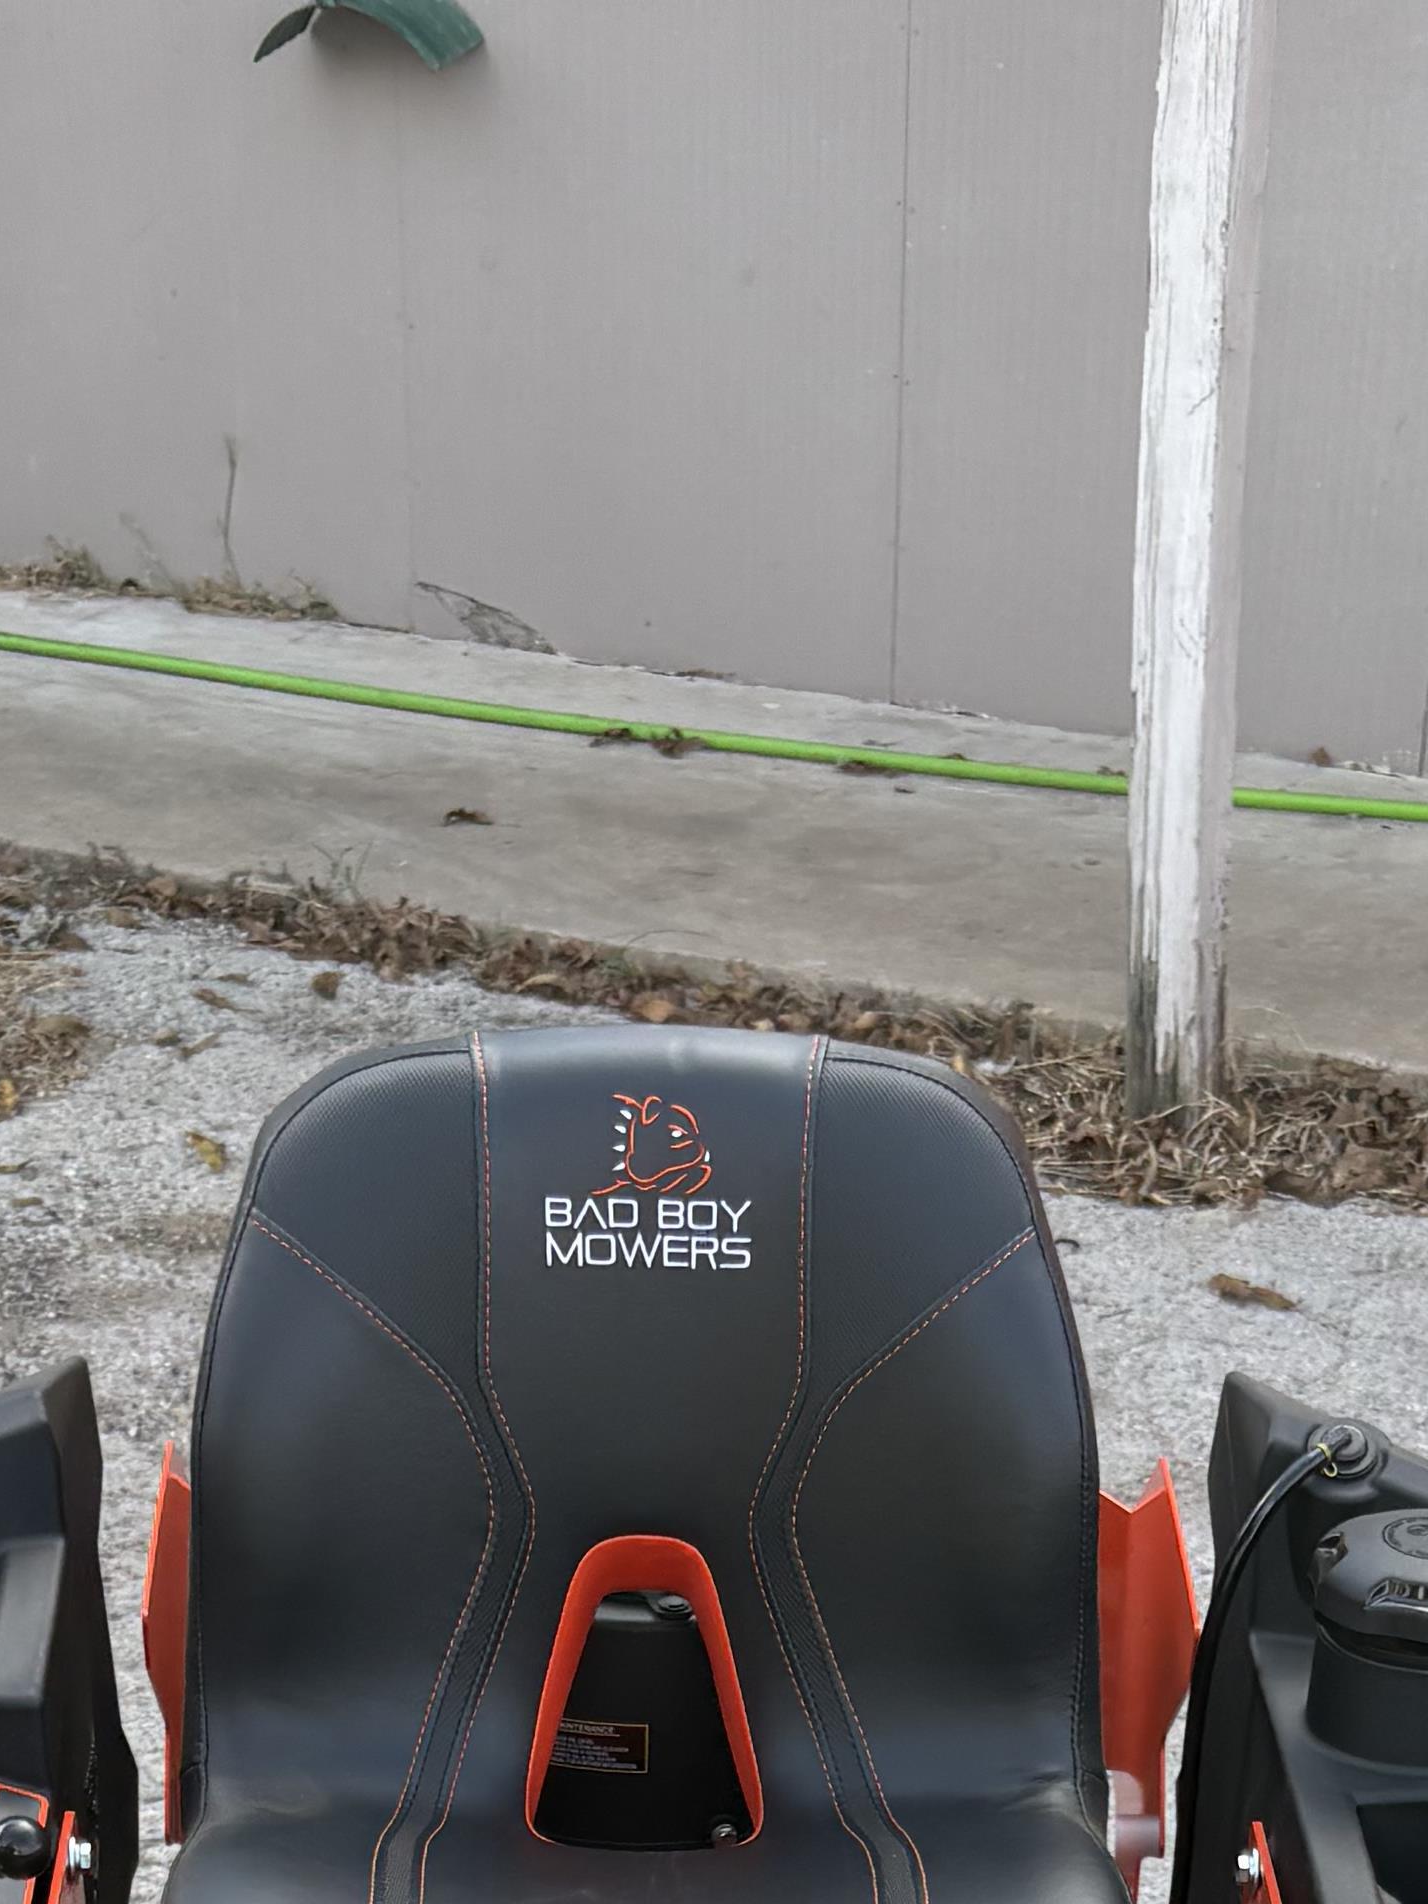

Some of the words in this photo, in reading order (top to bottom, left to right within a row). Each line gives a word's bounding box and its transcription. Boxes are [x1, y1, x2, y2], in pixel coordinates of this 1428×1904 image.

[545, 1197, 638, 1229] BAD
[658, 1199, 752, 1233] BOY
[546, 1231, 752, 1270] MOWERS
